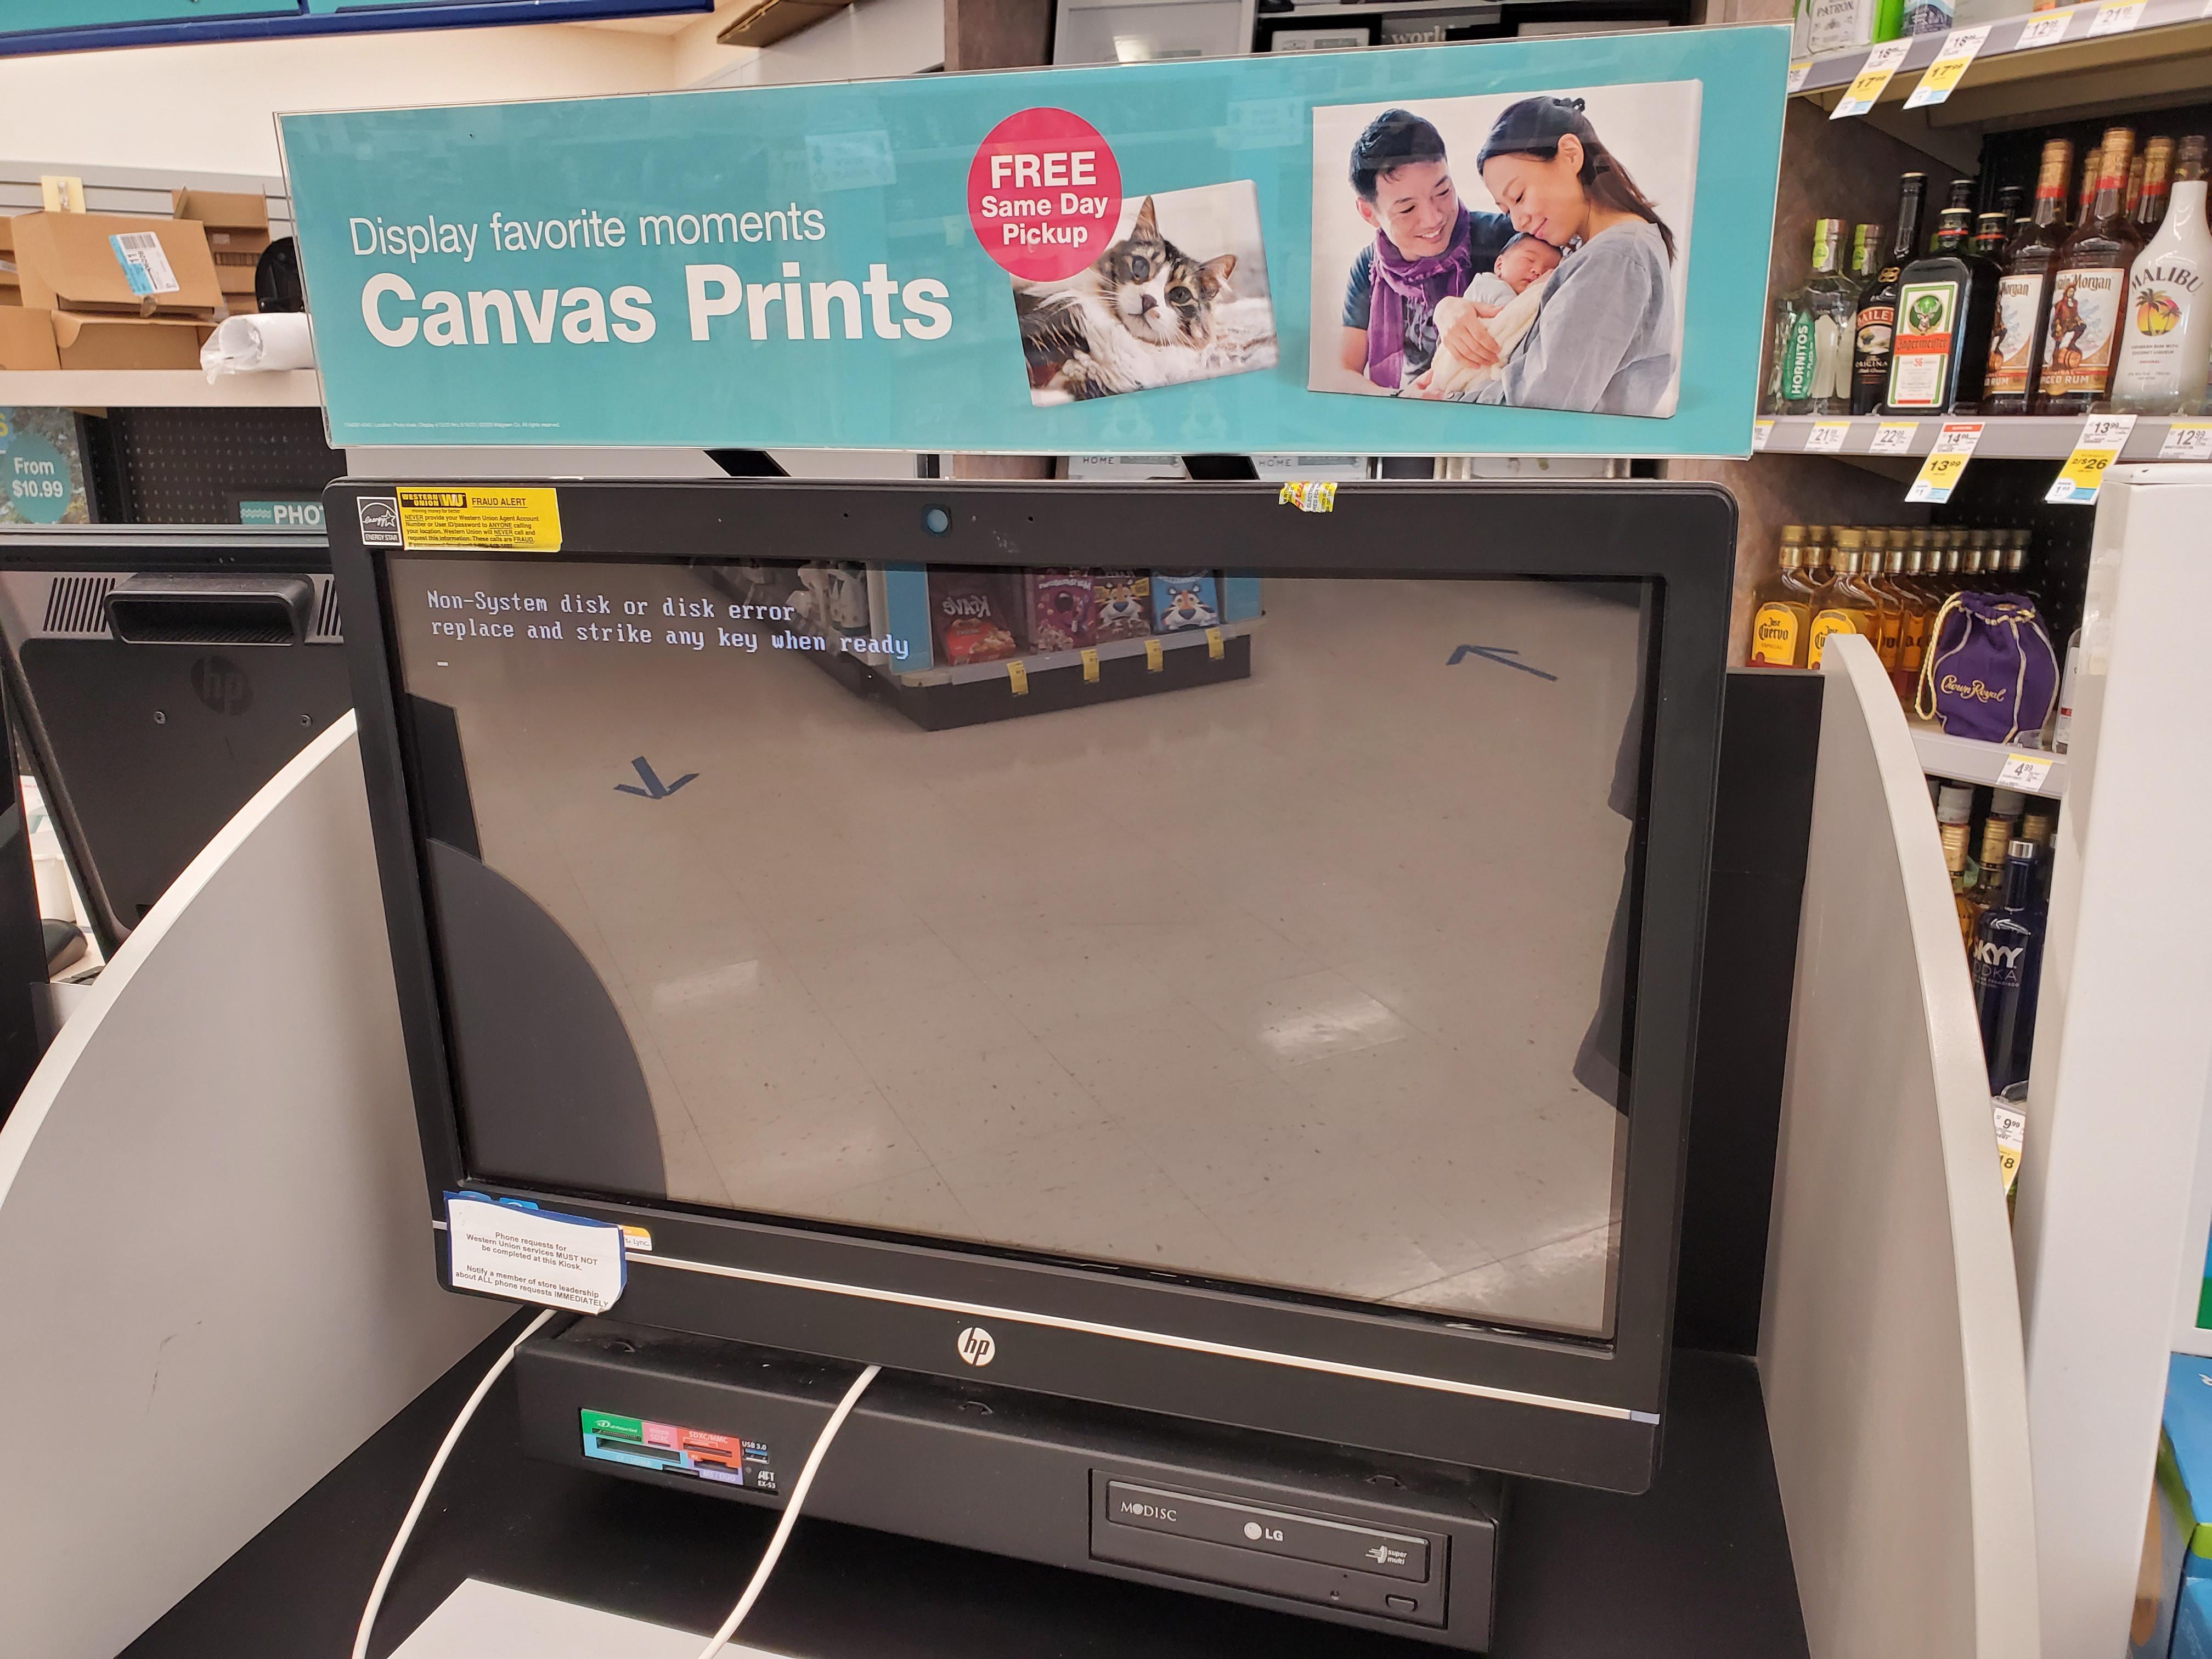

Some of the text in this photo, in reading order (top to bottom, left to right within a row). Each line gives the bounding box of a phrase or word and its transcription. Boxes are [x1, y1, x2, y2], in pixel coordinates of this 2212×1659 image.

[990, 150, 1097, 189] FREE
[981, 193, 1109, 218] Same Day
[349, 202, 826, 264] Display favorite moments
[1002, 223, 1088, 248] Pickup
[2073, 274, 2112, 291] Morgan
[2132, 266, 2204, 294] MALIBU
[361, 261, 953, 347] Canvas Prints
[1791, 325, 1809, 394] HORNITOS
[1855, 360, 1888, 369] ORIGINA
[1990, 377, 2009, 386] RUM
[2064, 375, 2089, 384] RUM
[13, 456, 55, 476] From
[1082, 456, 1114, 465] HOME
[1259, 459, 1291, 467] HOME
[12, 479, 64, 499] $10.99
[440, 494, 465, 507] WU
[472, 498, 526, 506] FRAUD ALERT
[427, 589, 795, 621] Non-System disk or disk error
[1768, 617, 1781, 627] Jose
[431, 618, 910, 660] replace and strike any key when ready
[1758, 623, 1789, 641] Cuervo
[1940, 674, 2007, 703] Crown Royal
[1973, 961, 2017, 982] ODKA
[2002, 1118, 2021, 1130] 999
[466, 1233, 598, 1266] Western Union services MUST NOT
[495, 1232, 567, 1252] Phone requests for
[633, 1238, 647, 1246] Lync
[493, 1248, 532, 1260] completed
[543, 1257, 556, 1265] this
[558, 1260, 583, 1271] Kiosk.
[455, 1271, 609, 1308] about ALL phone requests IMMEDIATELY
[467, 1265, 488, 1276] Notify
[496, 1272, 527, 1283] member
[538, 1281, 557, 1289] store
[558, 1284, 599, 1299] leadership
[962, 1327, 992, 1367] hp
[649, 1427, 670, 1436] micro
[650, 1434, 669, 1442] SDXC
[689, 1431, 729, 1444] SDXC/MMC
[741, 1440, 768, 1451] USB 3.0
[719, 1472, 736, 1482] DUO
[758, 1480, 777, 1489] EX-S3
[1265, 1528, 1284, 1542] LG
[1387, 1549, 1408, 1558] super
[1387, 1557, 1405, 1565] multi
